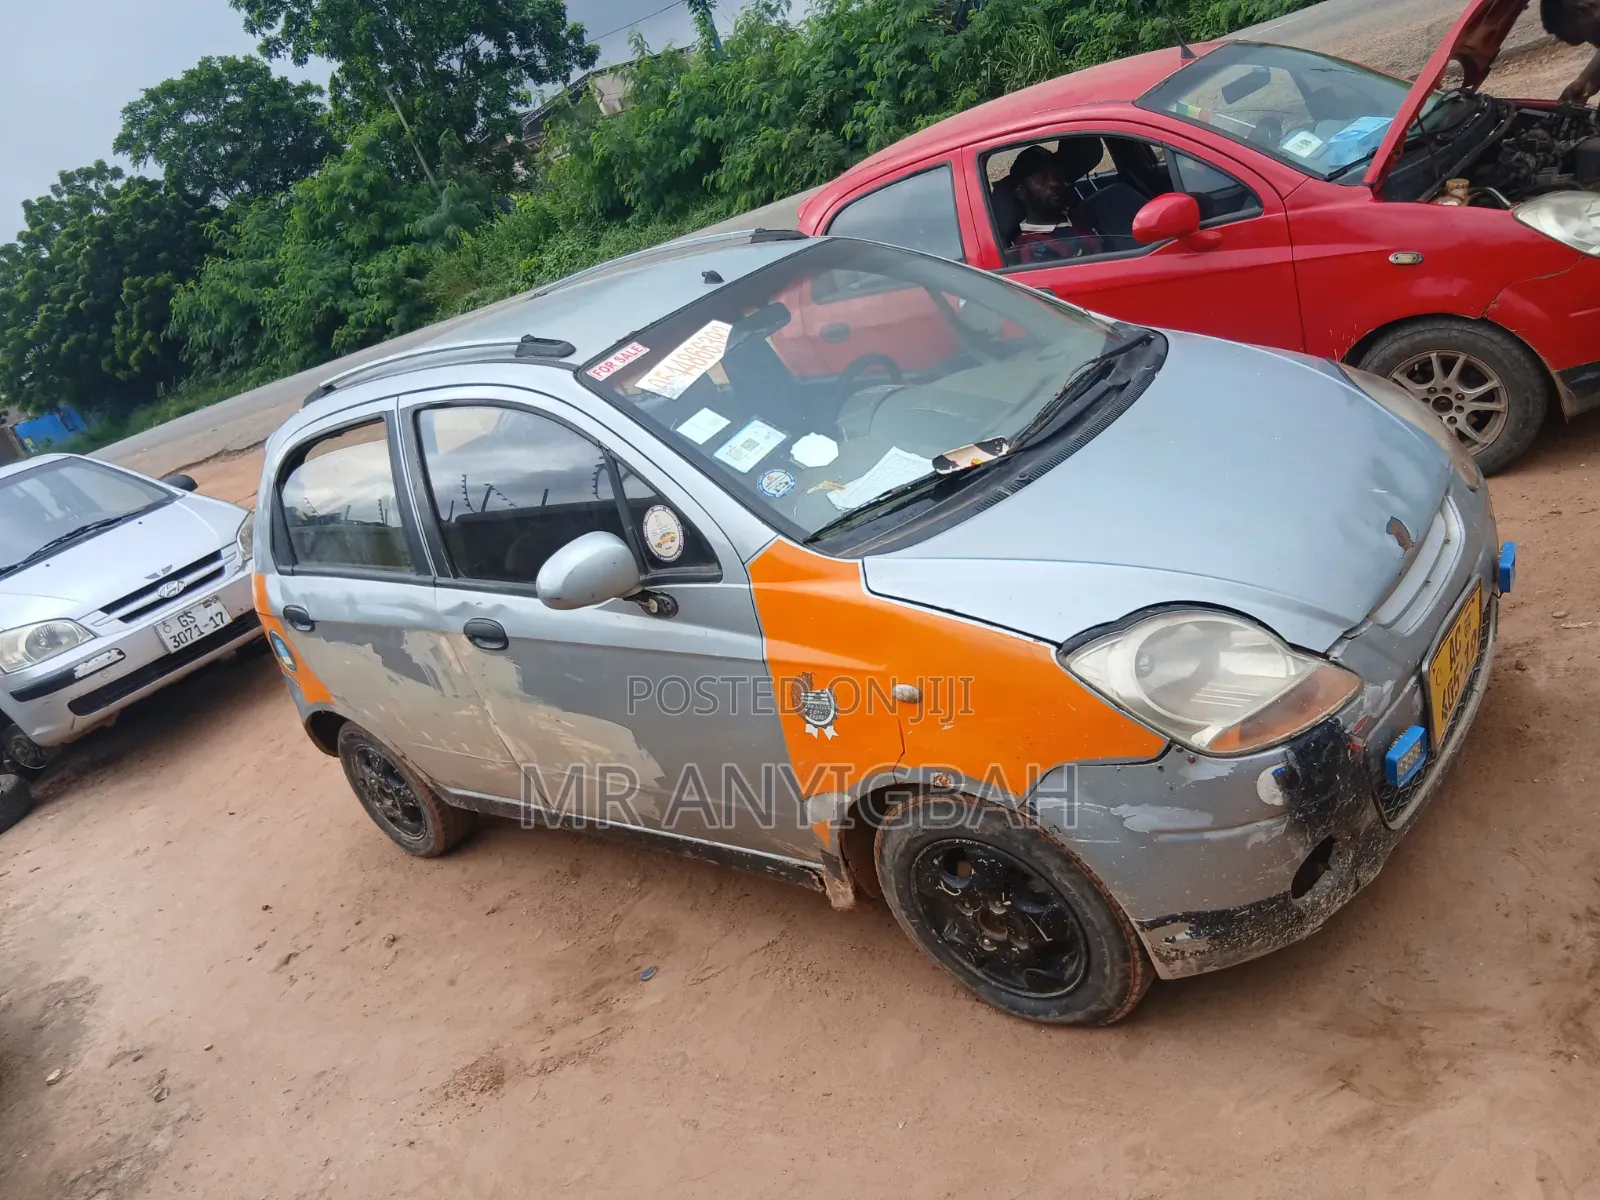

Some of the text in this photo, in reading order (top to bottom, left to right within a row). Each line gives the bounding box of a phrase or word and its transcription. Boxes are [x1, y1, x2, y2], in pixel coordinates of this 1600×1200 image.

[592, 345, 644, 377] FOR SALE
[177, 610, 196, 628] GS
[1449, 624, 1462, 672] AC
